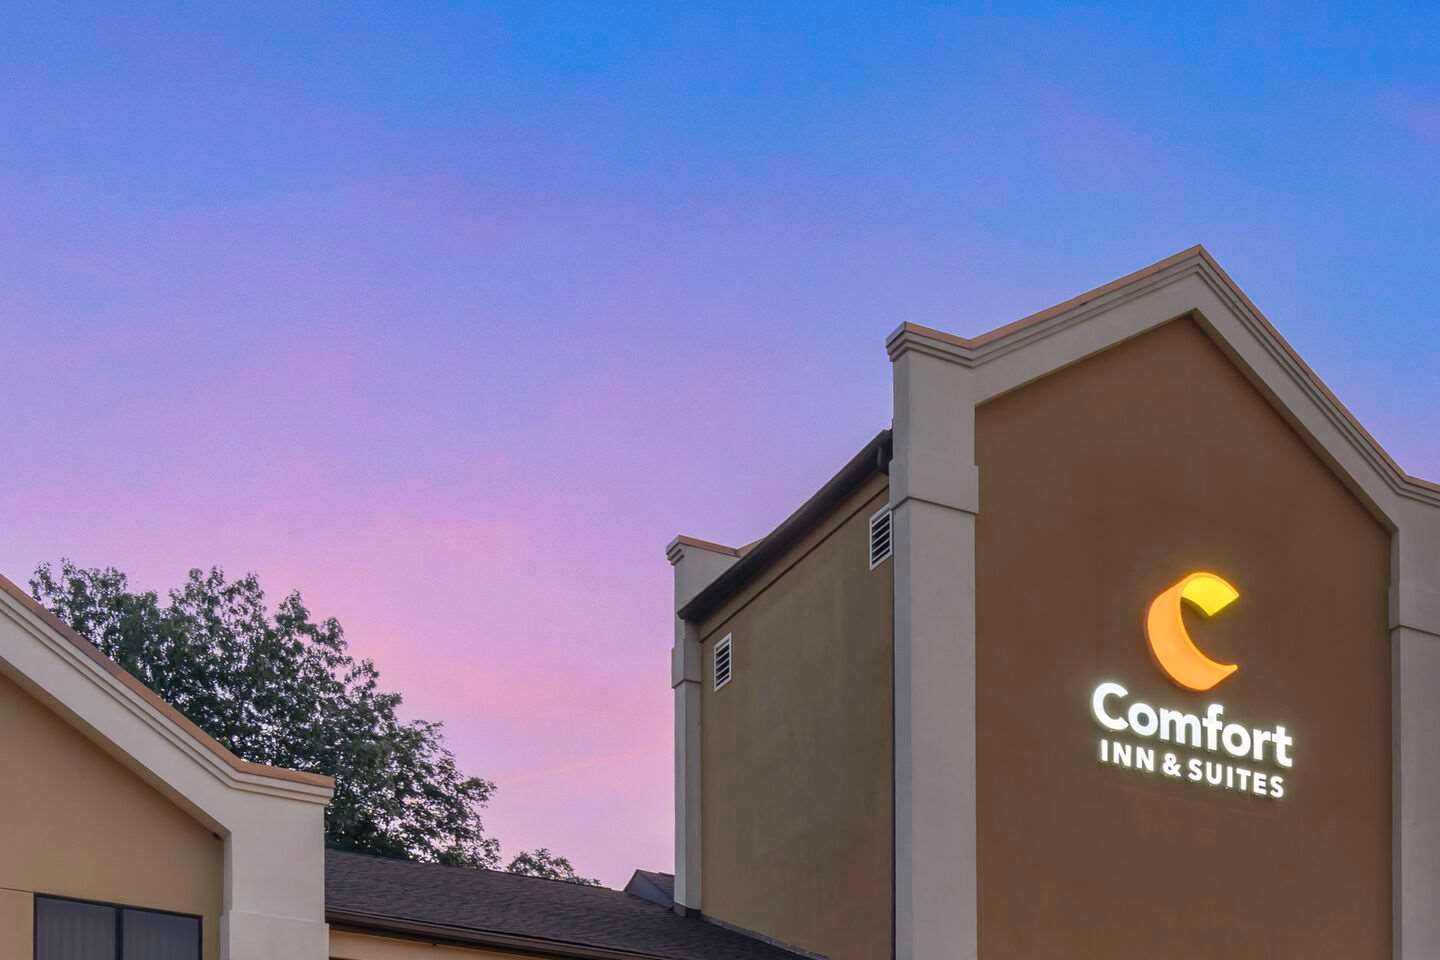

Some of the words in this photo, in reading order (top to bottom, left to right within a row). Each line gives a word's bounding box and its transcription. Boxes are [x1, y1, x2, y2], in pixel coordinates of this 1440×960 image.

[1092, 682, 1293, 768] Comfort
[1101, 739, 1155, 772] INN
[1162, 753, 1182, 777] &
[1188, 758, 1285, 799] SUITES
